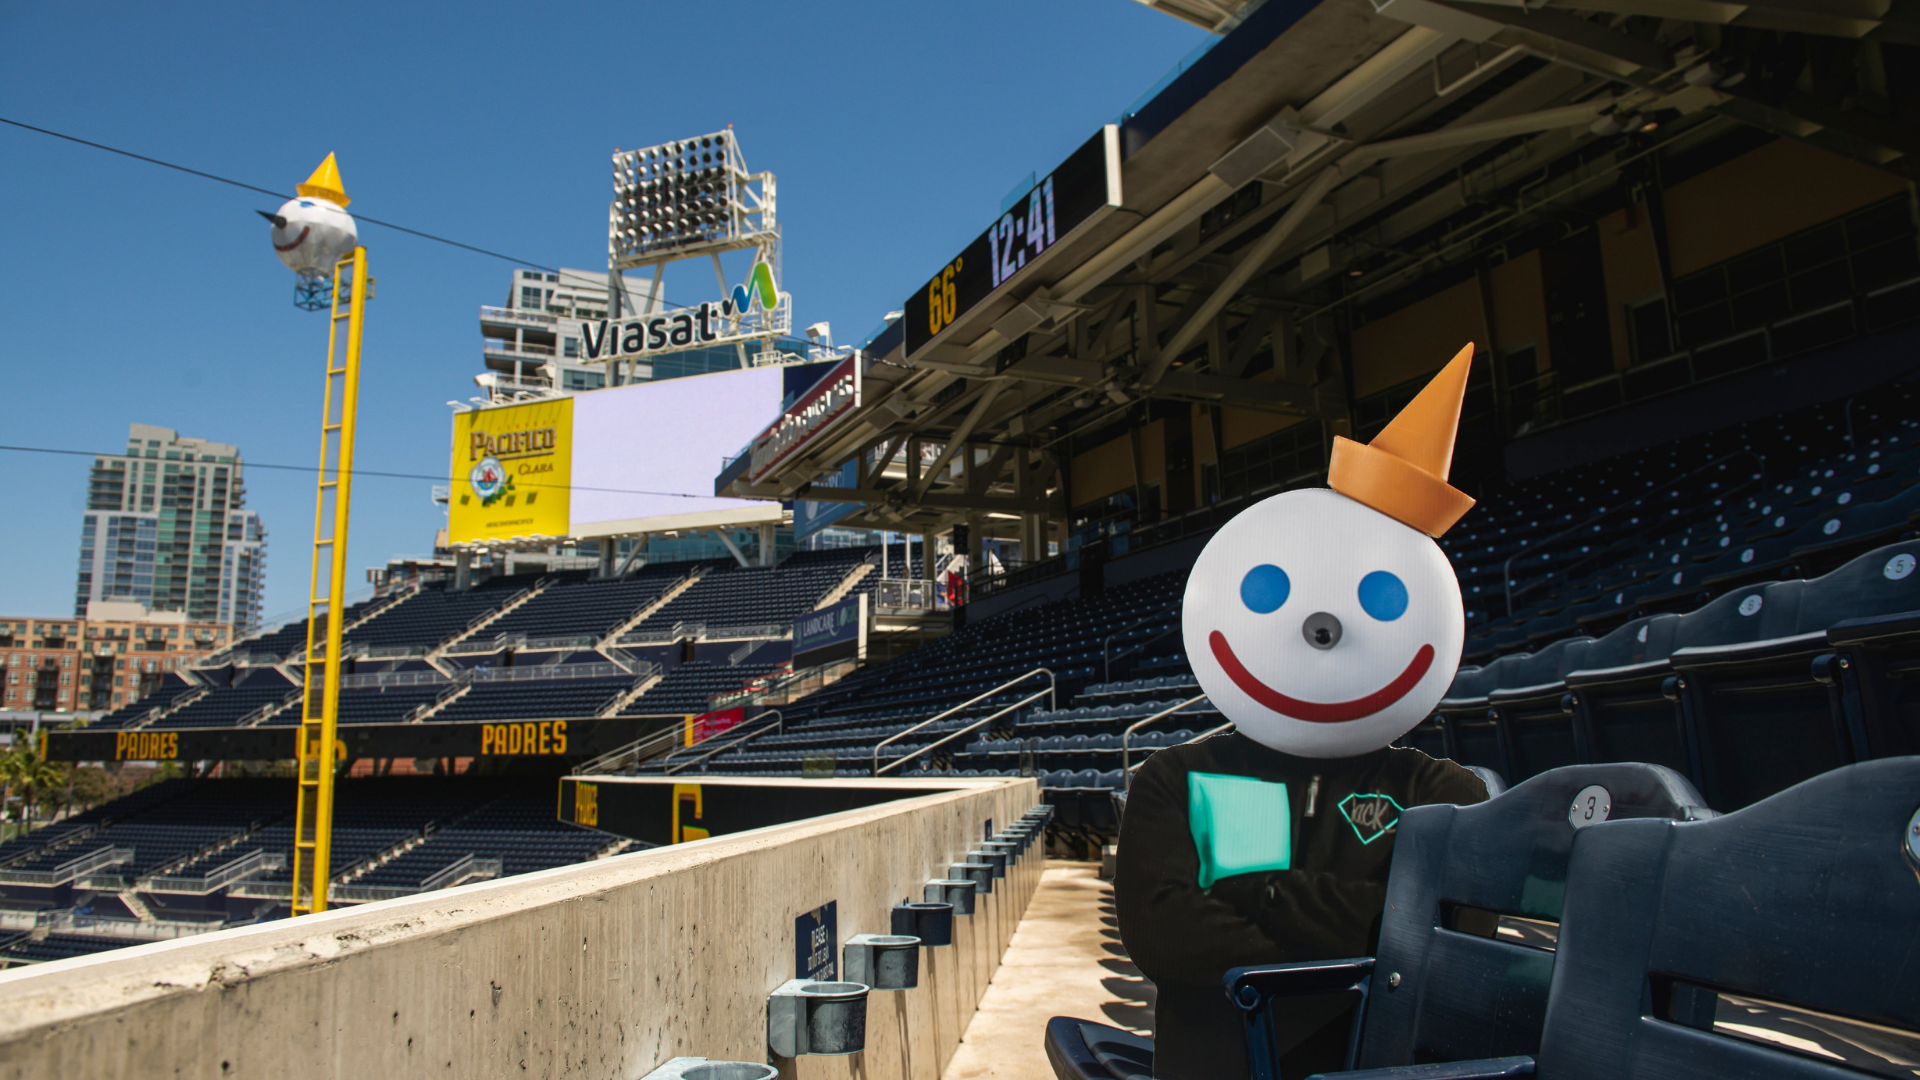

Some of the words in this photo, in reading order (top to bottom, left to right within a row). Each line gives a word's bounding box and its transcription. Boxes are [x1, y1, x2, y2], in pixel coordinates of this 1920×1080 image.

[988, 175, 1056, 288] 12:41
[582, 302, 716, 359] Viasat
[1896, 559, 1904, 573] 5
[115, 731, 179, 760] PADRES
[481, 720, 567, 755] PADRES
[1584, 796, 1596, 820] 3
